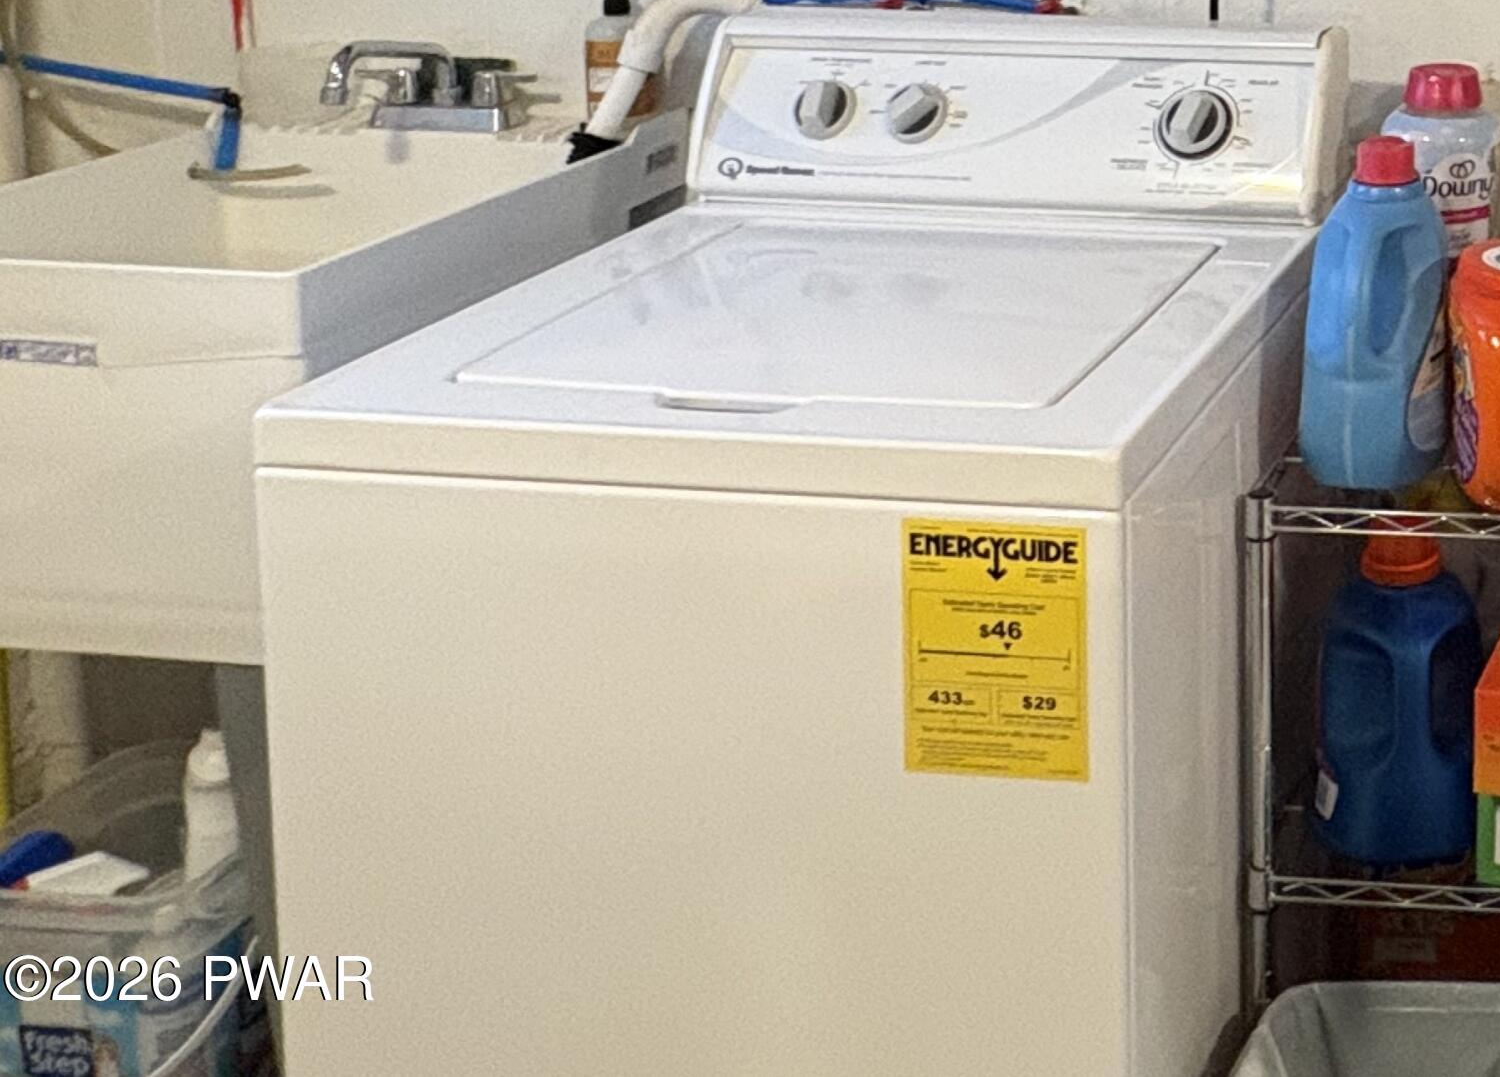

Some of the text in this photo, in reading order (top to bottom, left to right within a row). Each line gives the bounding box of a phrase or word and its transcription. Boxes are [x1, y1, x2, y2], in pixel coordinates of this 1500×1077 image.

[1422, 174, 1494, 200] Downy
[909, 533, 1079, 565] ENERGYGUIDE
[979, 620, 1023, 640] $46
[928, 690, 963, 706] 433
[1022, 695, 1057, 711] $29
